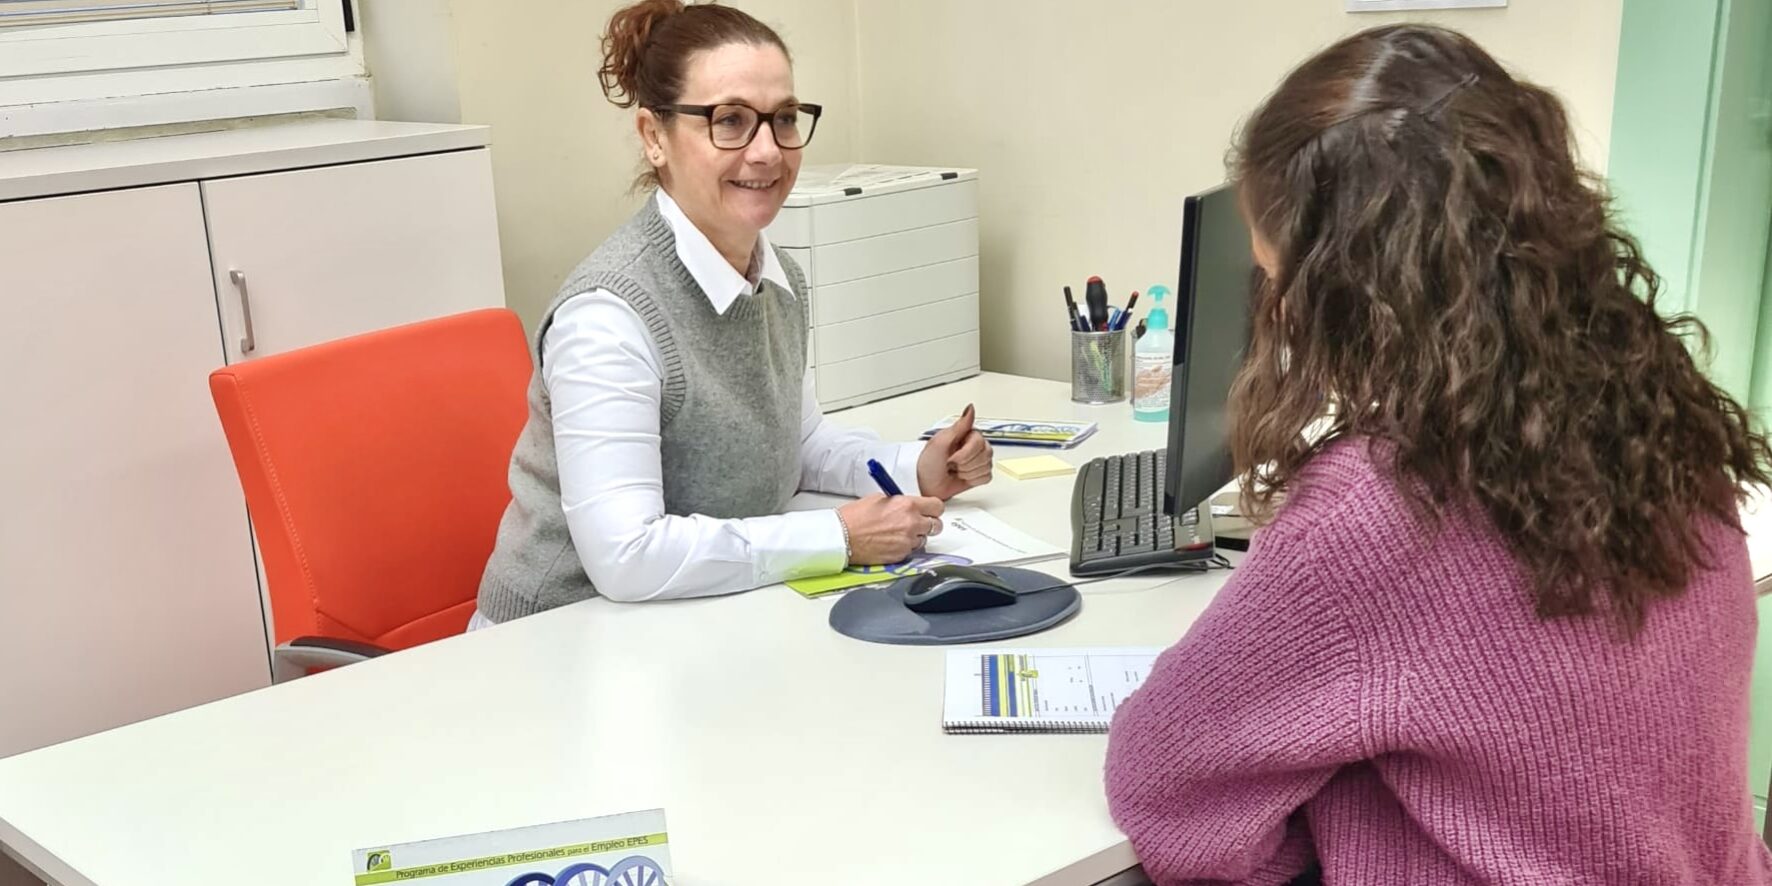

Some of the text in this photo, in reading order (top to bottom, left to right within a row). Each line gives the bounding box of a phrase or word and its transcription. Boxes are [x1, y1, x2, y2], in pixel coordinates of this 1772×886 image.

[396, 867, 436, 879] Programa
[437, 864, 449, 873] de
[450, 856, 505, 872] Experiencias
[507, 848, 565, 863] Profesionales
[567, 847, 582, 856] para
[591, 839, 625, 852] Empleo
[626, 836, 649, 846] EPES
